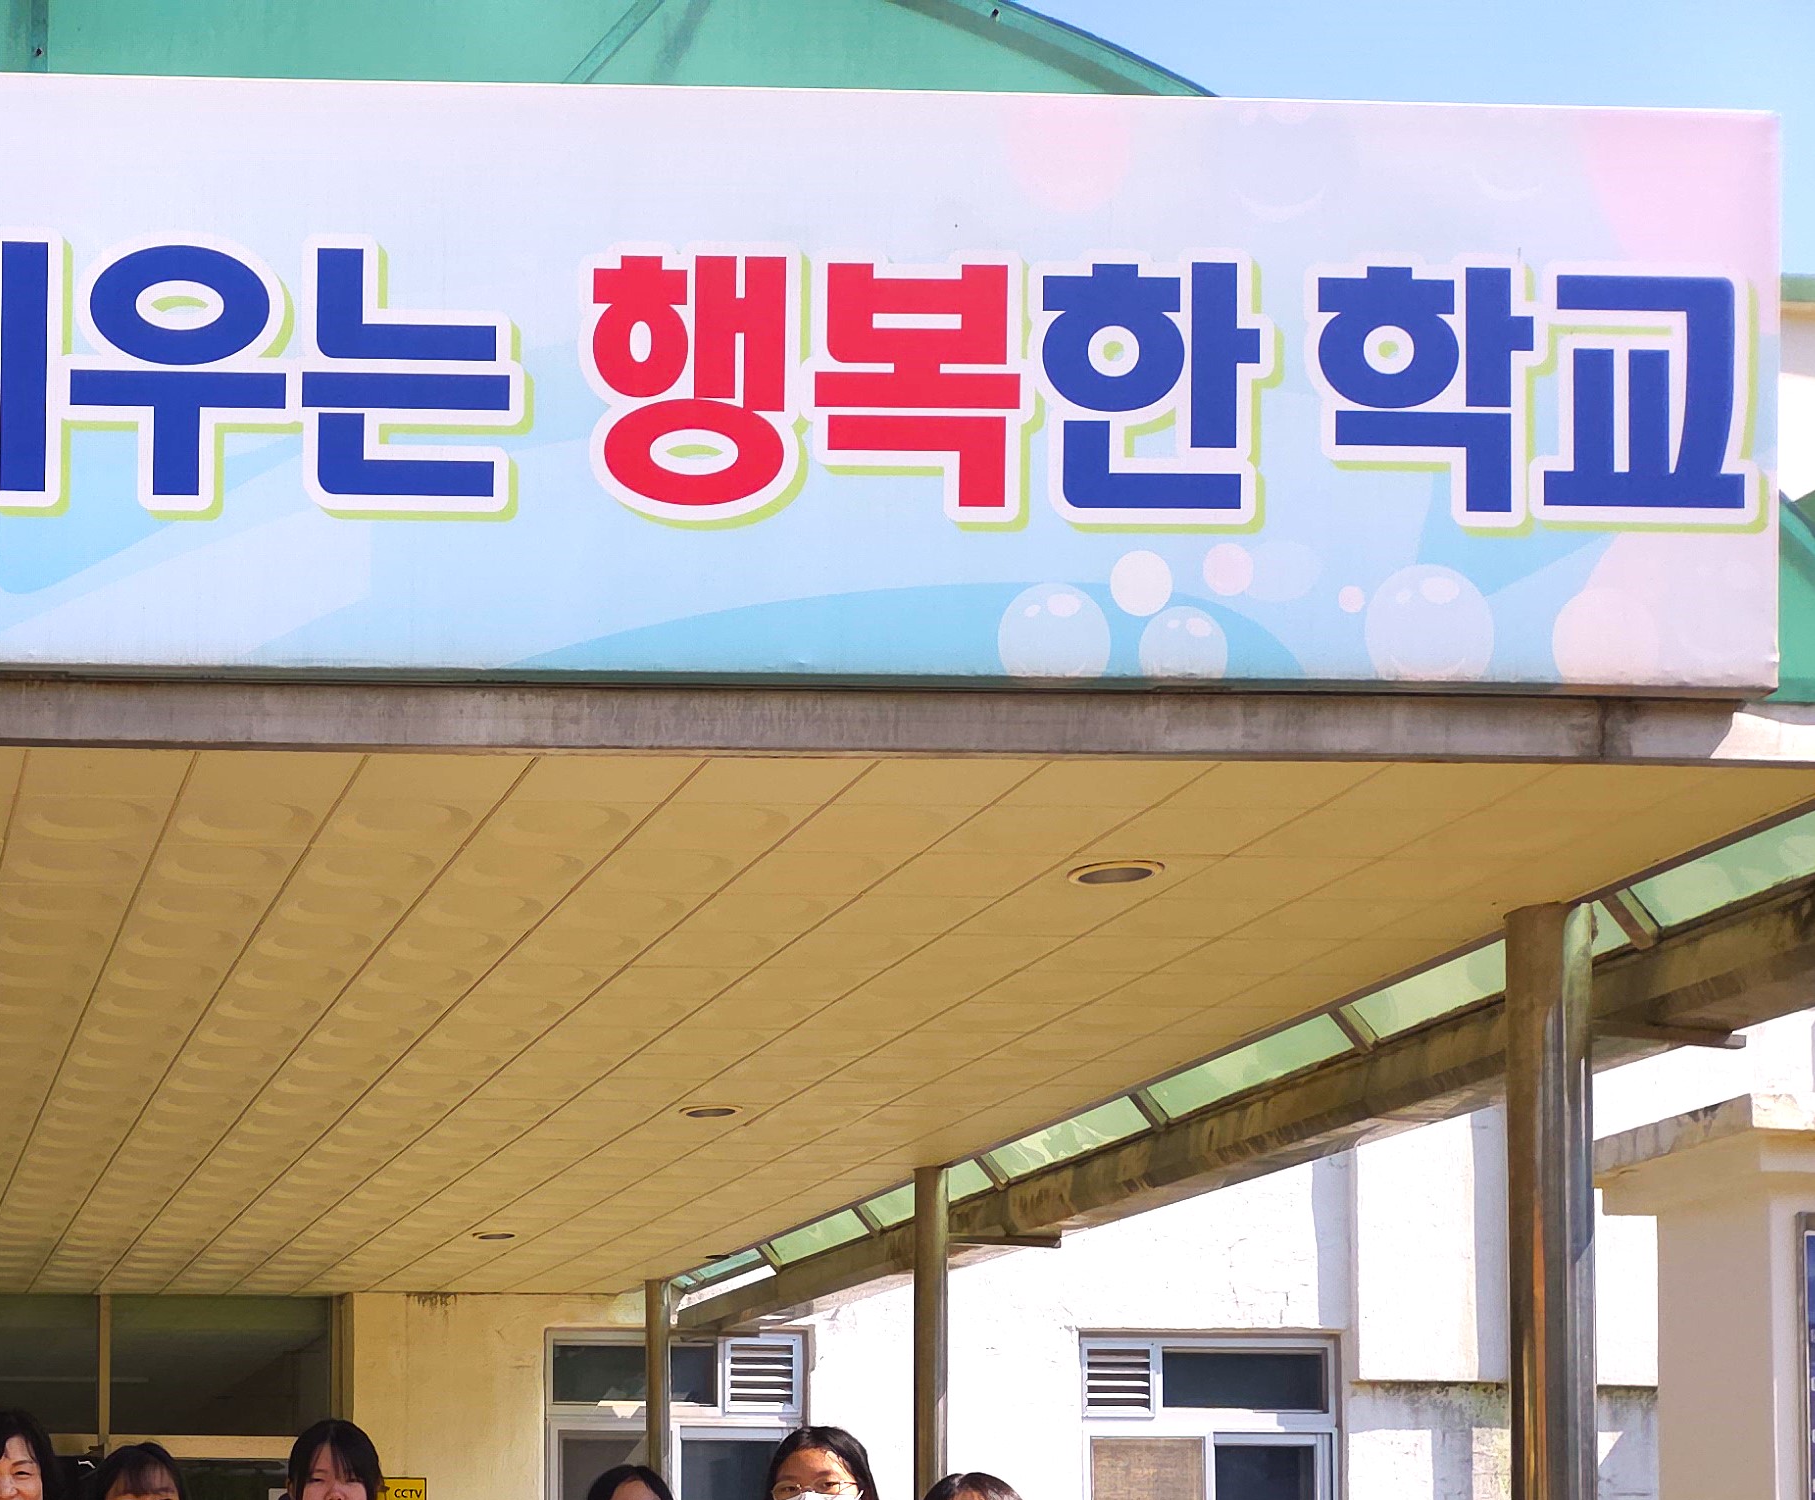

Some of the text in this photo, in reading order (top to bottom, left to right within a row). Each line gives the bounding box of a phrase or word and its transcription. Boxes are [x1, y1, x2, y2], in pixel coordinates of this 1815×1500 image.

[594, 257, 1259, 508] 행복한
[1320, 268, 1744, 512] 학교
[394, 1489, 422, 1498] CCTV
